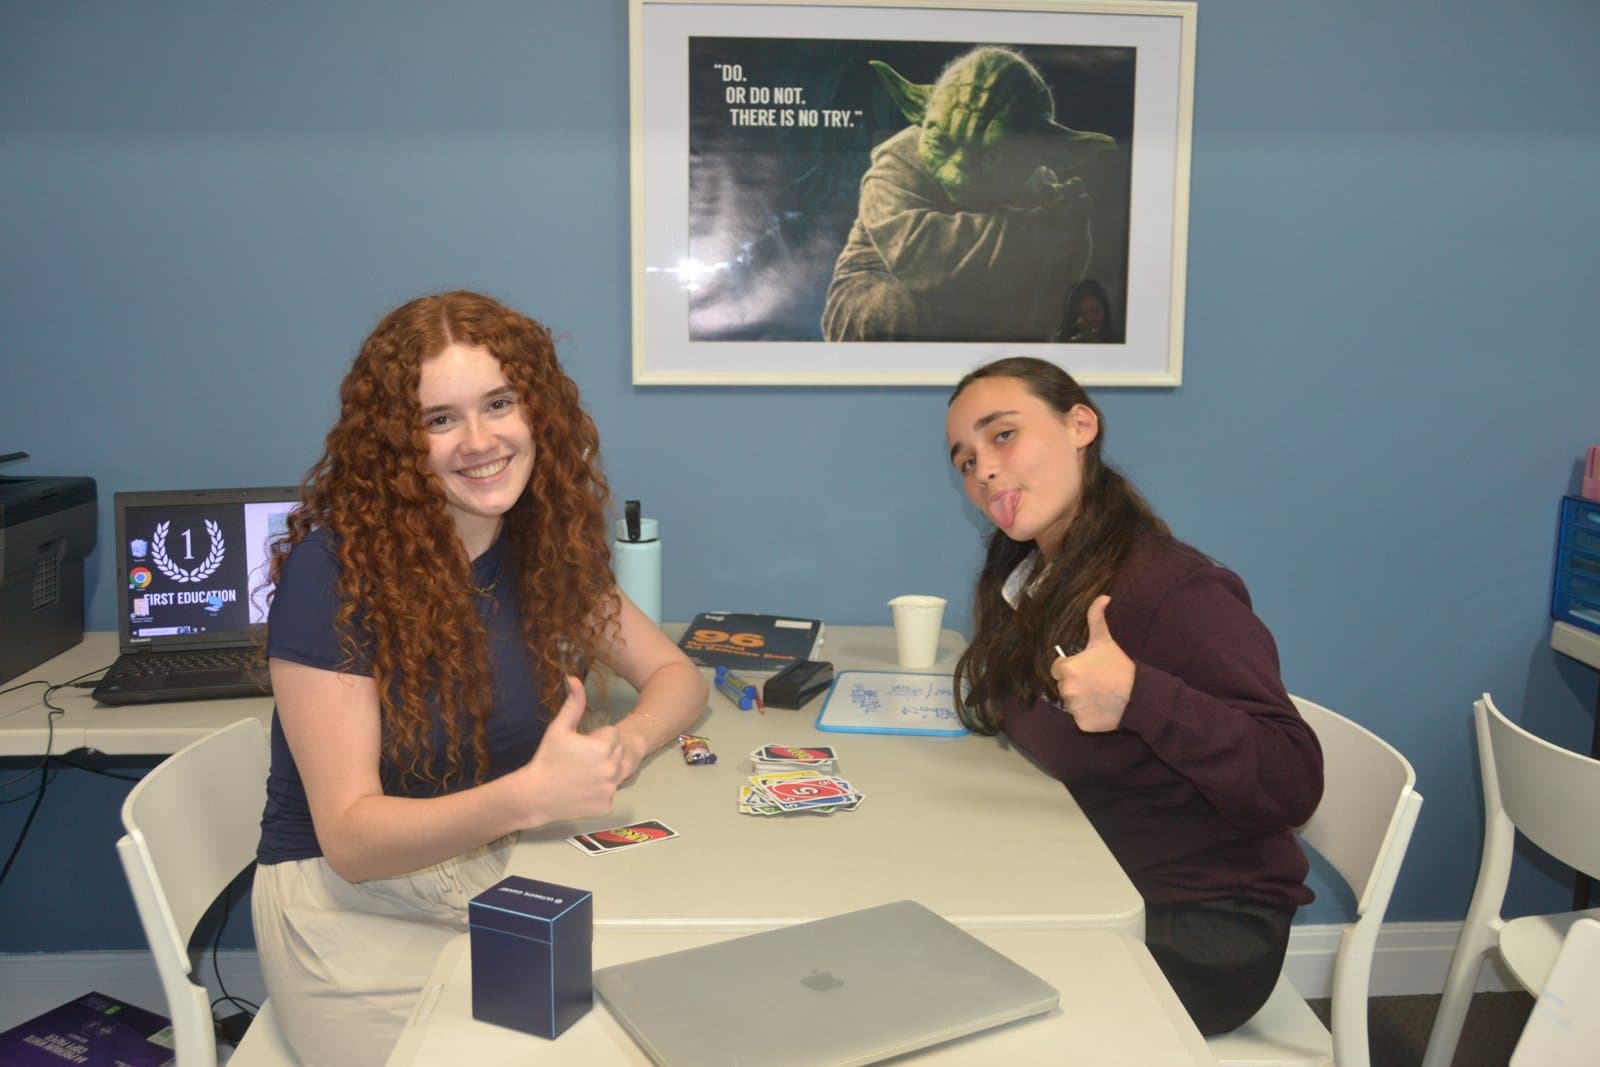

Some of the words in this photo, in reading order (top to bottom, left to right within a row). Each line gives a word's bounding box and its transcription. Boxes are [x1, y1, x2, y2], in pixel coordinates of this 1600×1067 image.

[725, 86, 746, 104] OR
[750, 87, 770, 104] DO
[773, 87, 806, 105] NOT.
[730, 109, 776, 126] THERE
[780, 109, 795, 126] IS
[798, 110, 818, 127] NO
[181, 528, 195, 560] 1
[143, 592, 175, 606] FIRST
[692, 629, 765, 648] 96
